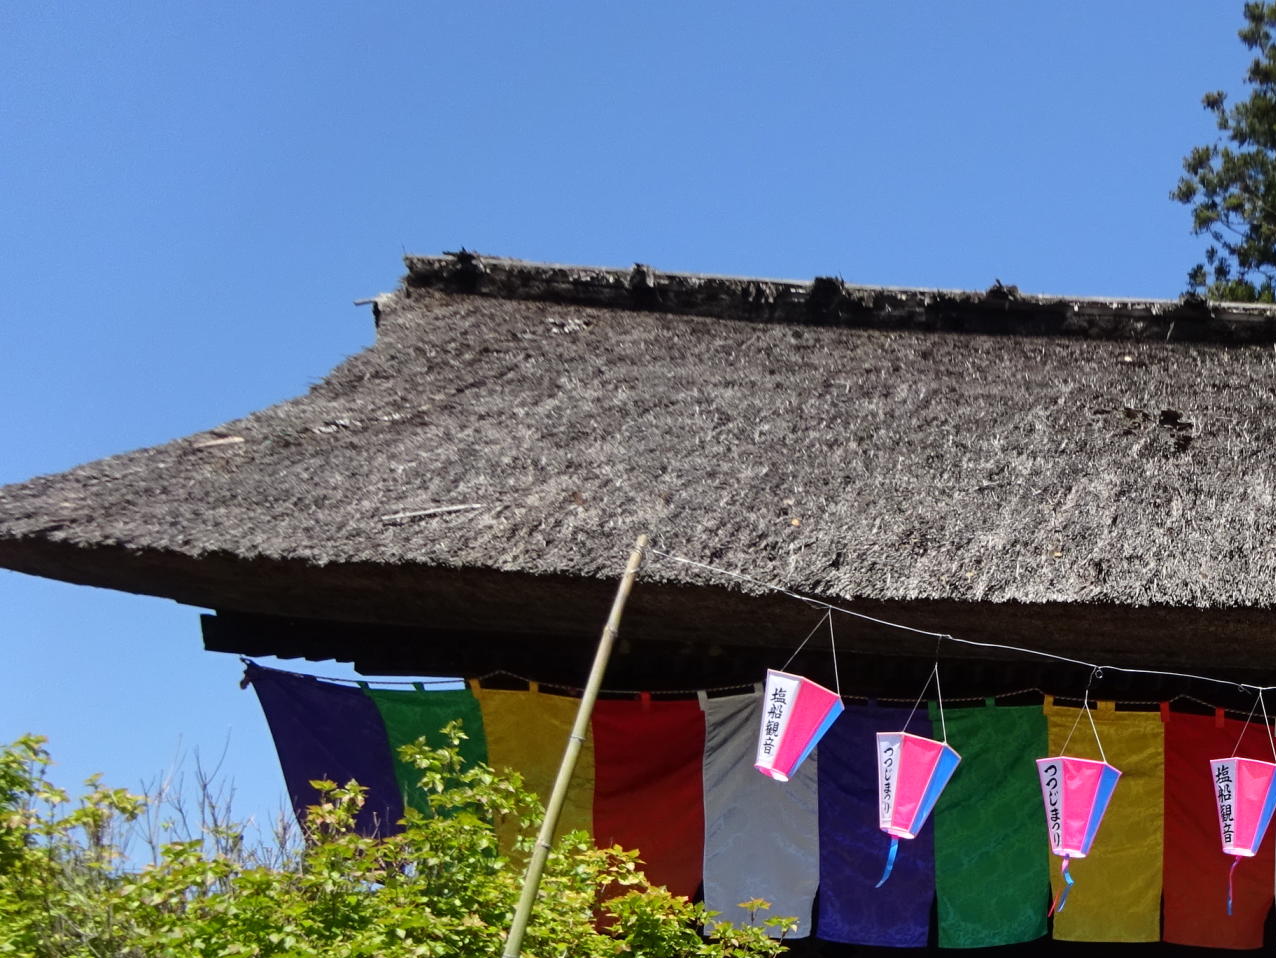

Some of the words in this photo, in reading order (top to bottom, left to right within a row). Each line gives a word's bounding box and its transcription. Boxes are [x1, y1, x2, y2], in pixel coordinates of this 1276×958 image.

[762, 687, 787, 754] 塩船観音
[883, 747, 894, 813] つつじまつり
[1044, 764, 1060, 847] つつじまつり
[1215, 764, 1235, 843] 塩船観音
